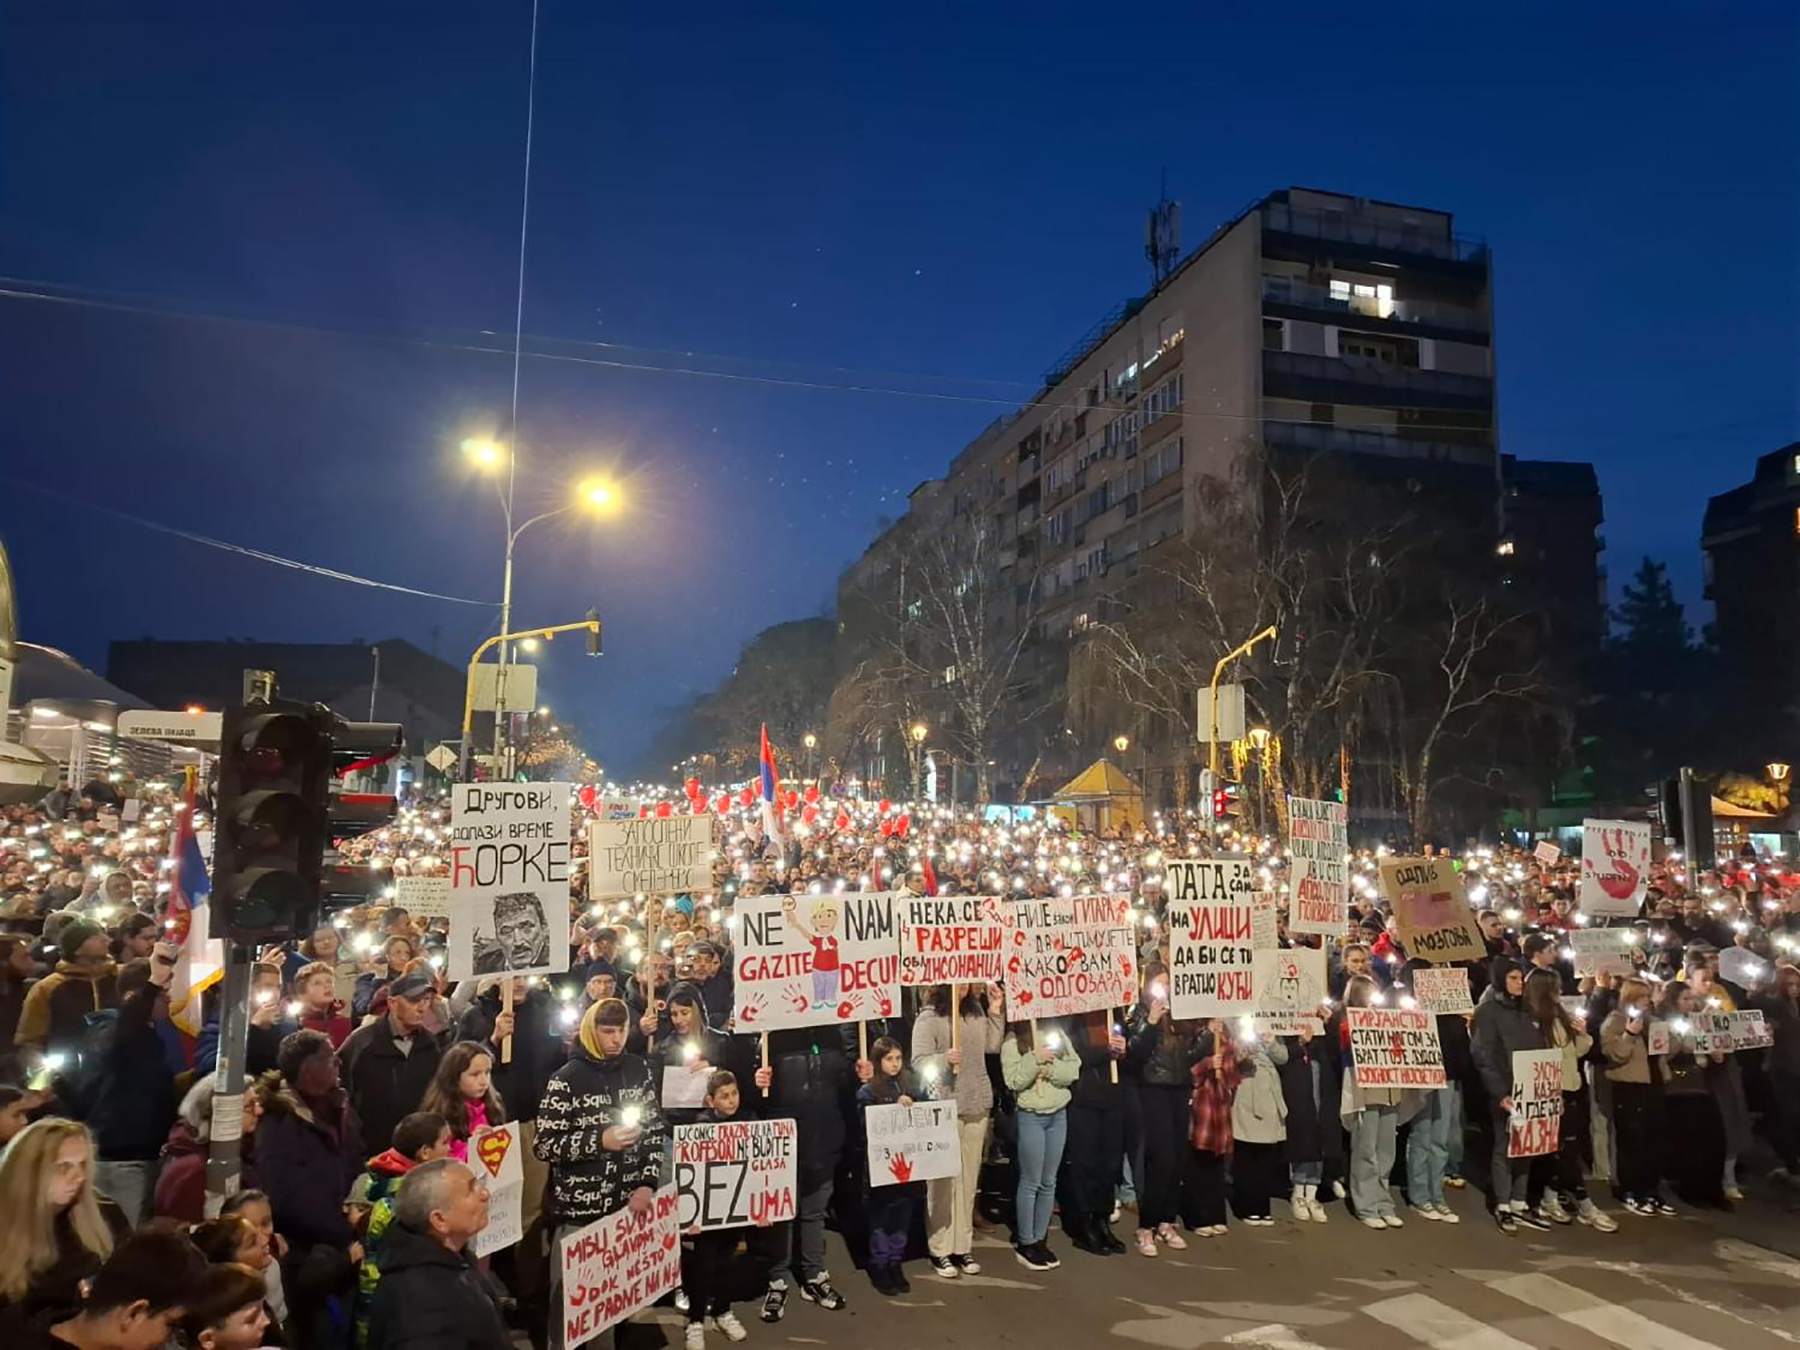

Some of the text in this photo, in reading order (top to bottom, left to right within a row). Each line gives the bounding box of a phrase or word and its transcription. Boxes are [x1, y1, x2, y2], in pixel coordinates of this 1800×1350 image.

[453, 821, 554, 841] ДОЛАЗИ ВРЕМЕ
[452, 842, 568, 888] ЋОРКЕ
[1168, 863, 1249, 904] ТАТА, ЈА
[743, 898, 893, 946] NE NAM
[910, 901, 983, 925] НЕКА СЕ
[1016, 903, 1051, 928] НИЈЕ
[1073, 897, 1115, 924] ГИТАРА
[1172, 911, 1189, 928] НА
[1189, 906, 1250, 941] УЛИЦИ
[916, 926, 1002, 952] РАЗРЕШИ
[1413, 926, 1473, 954] МОЗГОВА
[739, 952, 898, 993] GAZITE DECU!
[1024, 952, 1112, 977] КАКО ВАМ
[1174, 946, 1194, 968] ДА
[1198, 946, 1216, 964] БИ
[1221, 946, 1235, 964] СЕ
[1174, 973, 1216, 996] ВРАТИО
[1351, 1029, 1385, 1046] СТАТИ
[675, 1158, 787, 1230] BEZ GLASA
[749, 1186, 794, 1221] UMA
[567, 1309, 590, 1342] NE
[594, 1280, 643, 1327] PADNE
[645, 1269, 660, 1297] NA
